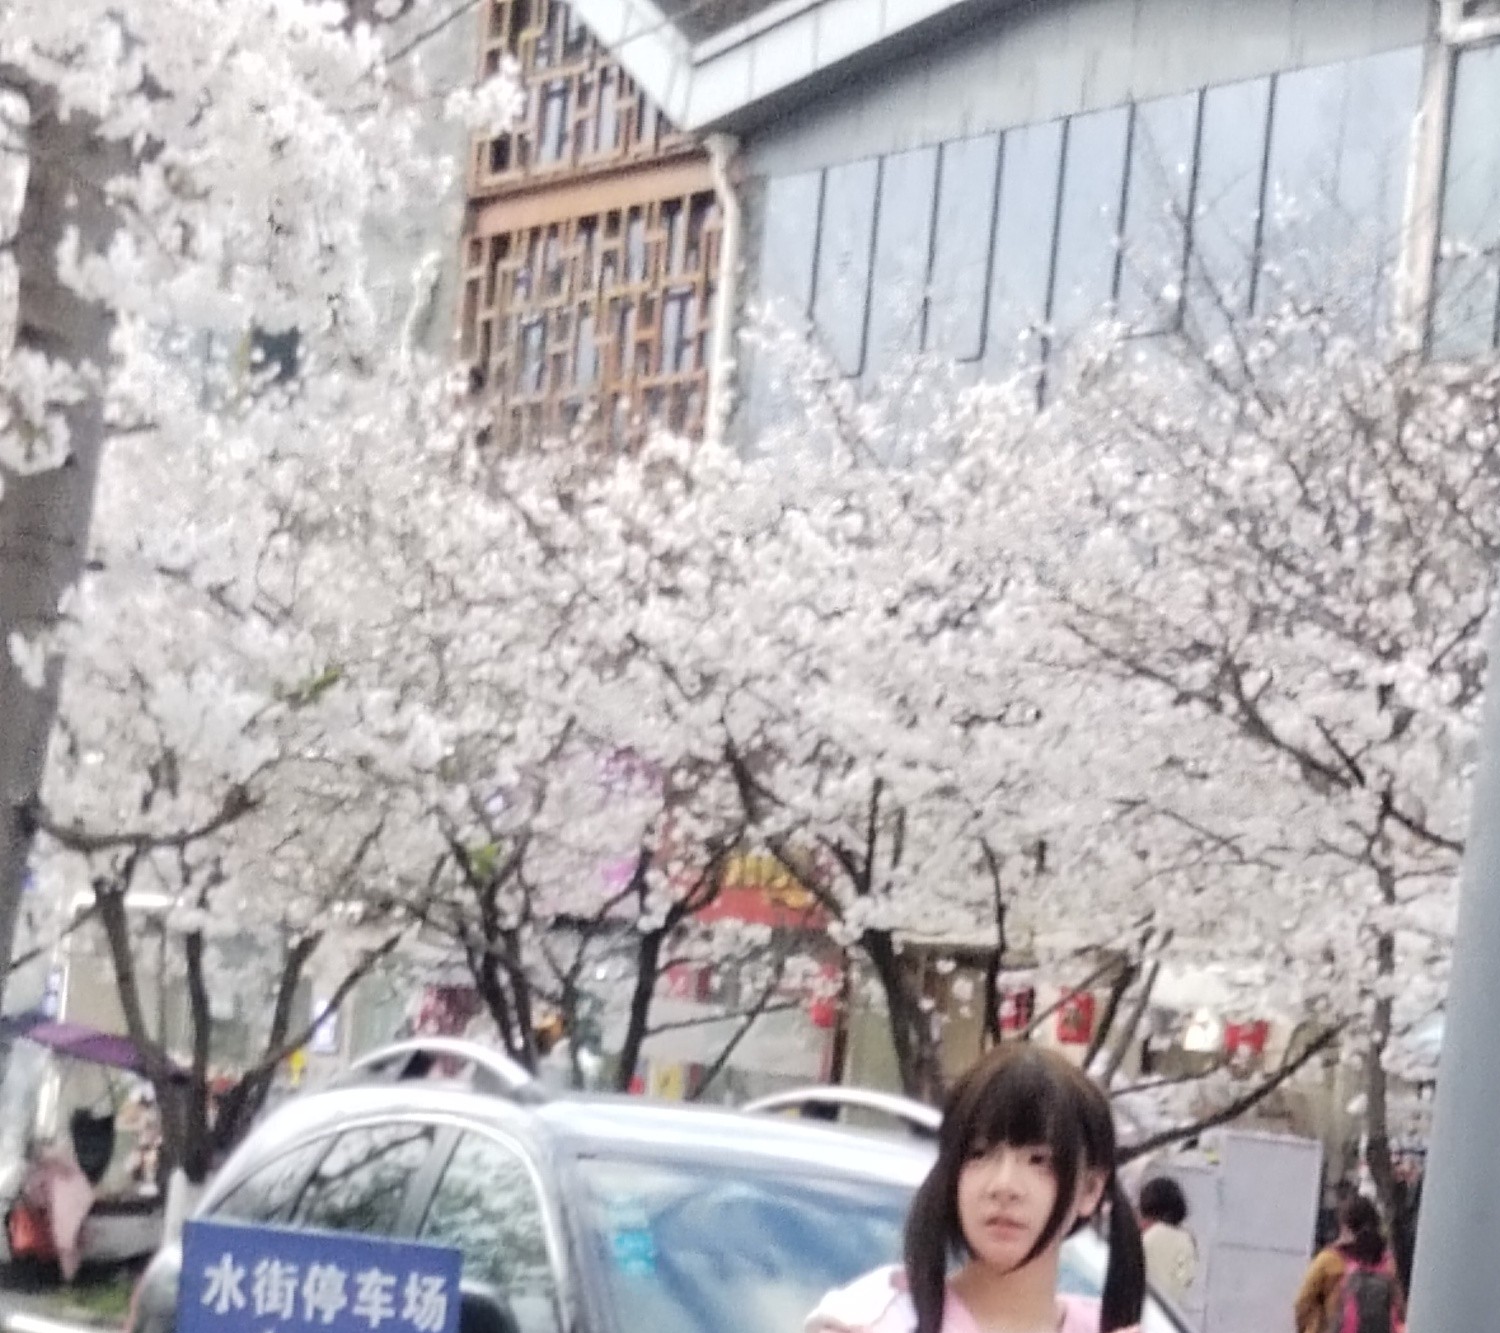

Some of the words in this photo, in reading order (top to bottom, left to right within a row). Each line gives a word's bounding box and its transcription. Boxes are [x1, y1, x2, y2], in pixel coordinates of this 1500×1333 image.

[201, 1254, 447, 1333] 水街停车场
